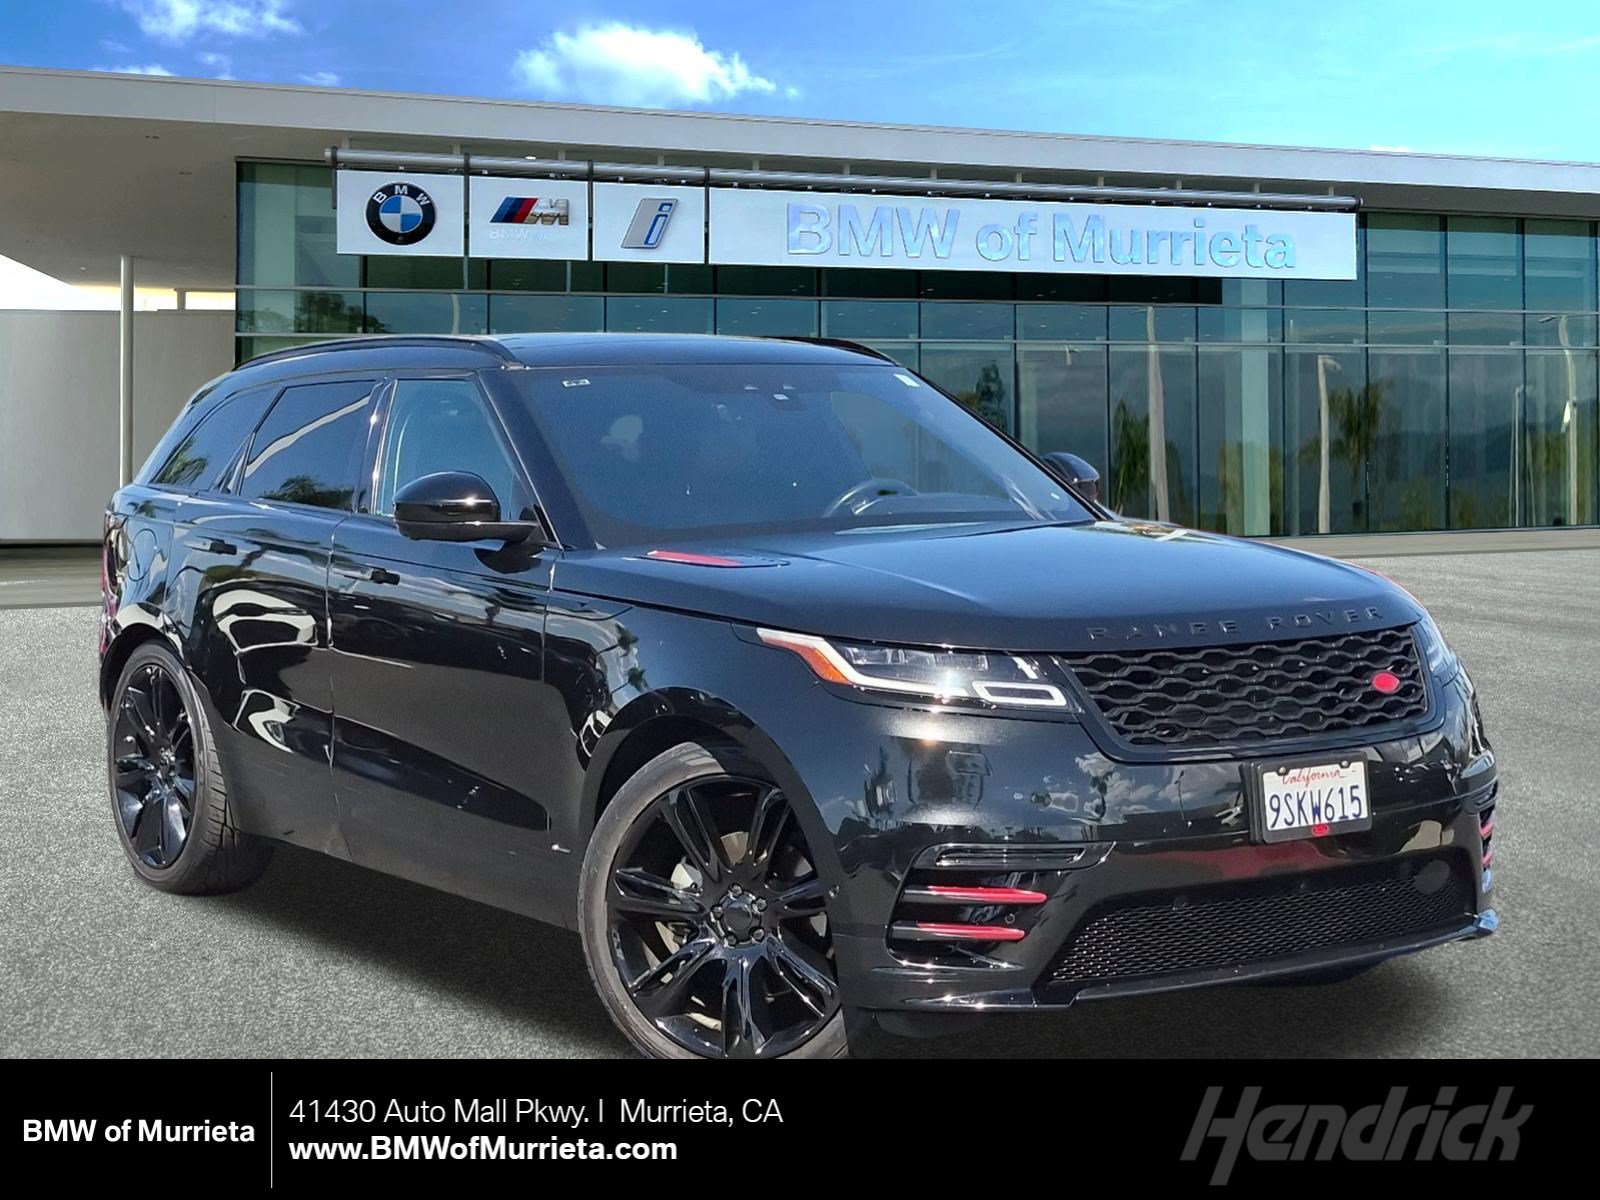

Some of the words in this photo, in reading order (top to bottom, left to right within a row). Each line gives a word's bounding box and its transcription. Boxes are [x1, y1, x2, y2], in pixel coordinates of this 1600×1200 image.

[372, 184, 430, 206] BMW
[786, 202, 961, 259] BMW
[975, 212, 1038, 262] of
[1052, 212, 1297, 269] Murrieta
[1087, 618, 1240, 641] RANGE
[1265, 605, 1384, 631] ROVER
[1281, 767, 1347, 788] California
[1269, 784, 1362, 829] 9SKW615
